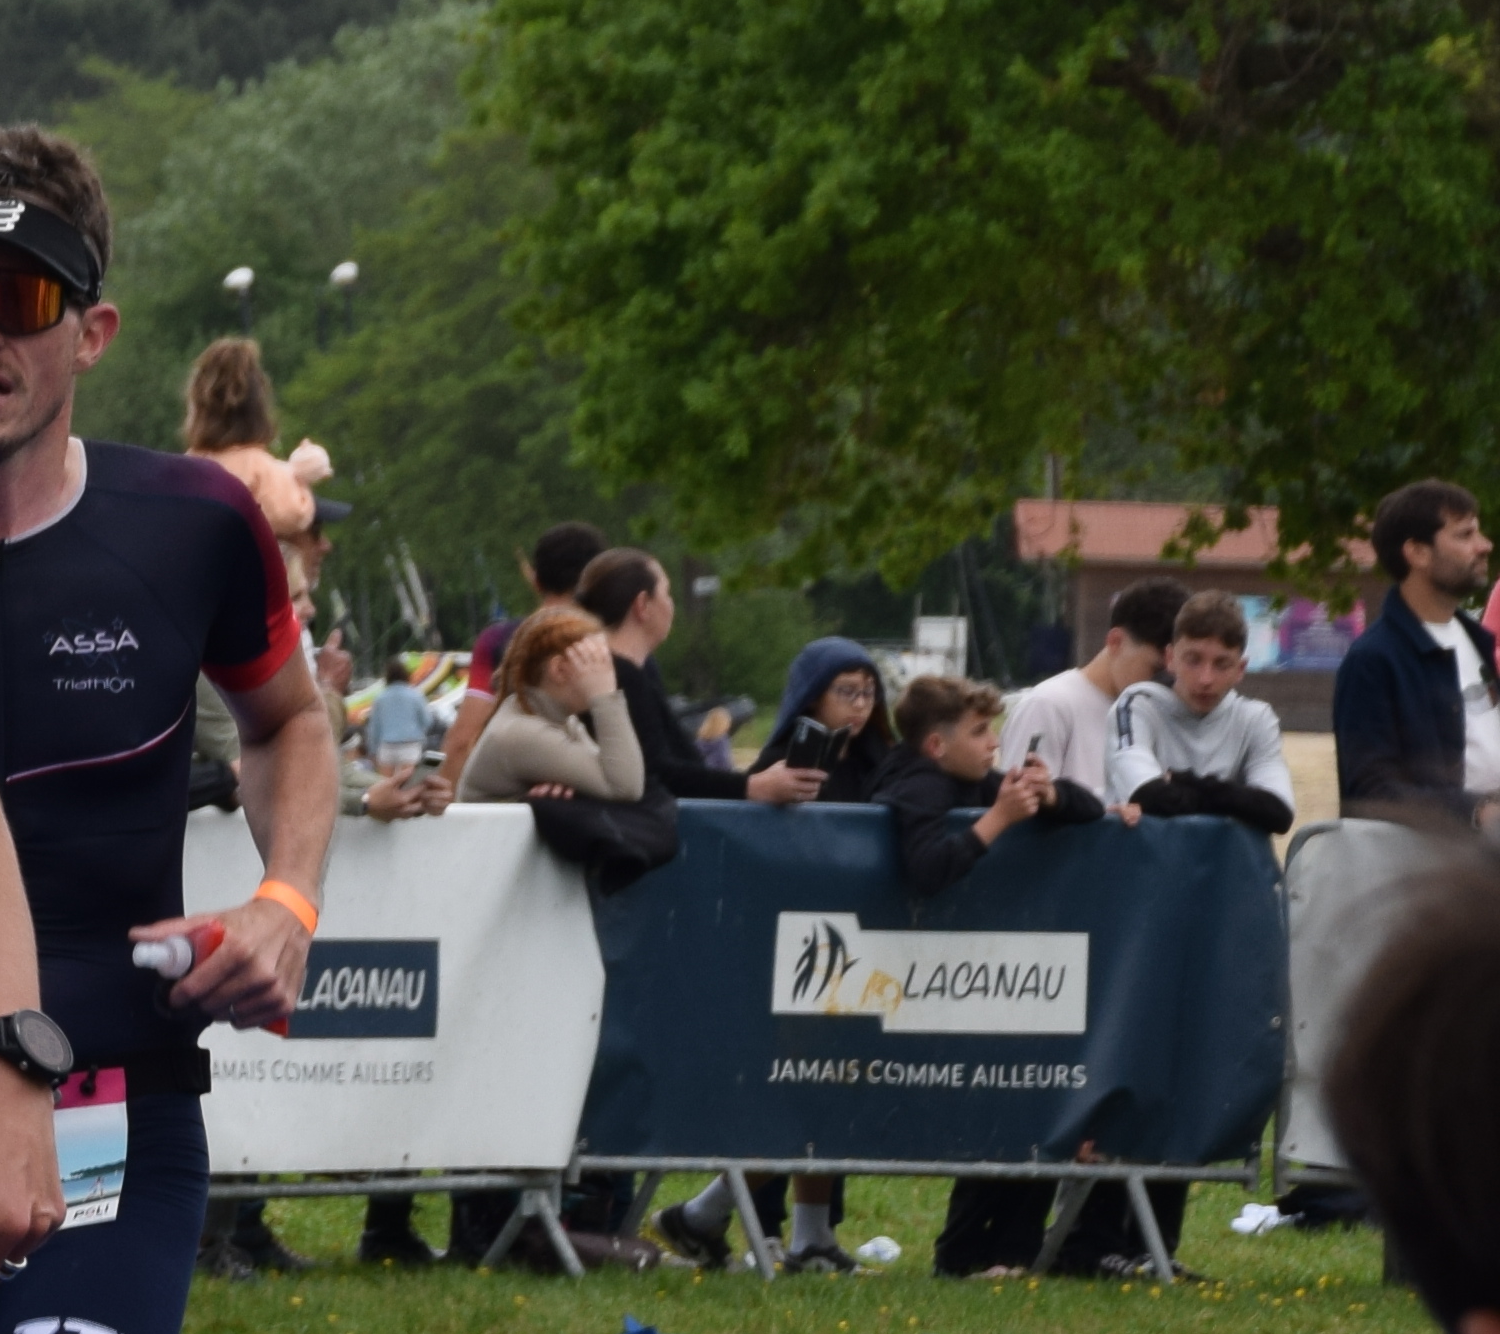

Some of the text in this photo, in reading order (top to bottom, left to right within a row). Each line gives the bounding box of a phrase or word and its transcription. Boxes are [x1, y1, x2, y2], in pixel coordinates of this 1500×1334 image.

[49, 629, 139, 656] ASSA
[295, 965, 426, 1011] LACANAU
[902, 960, 1067, 1004] LACANAU
[212, 1058, 435, 1085] AMAIS COMME AILLEURS
[767, 1057, 1088, 1089] JAMAIS COMME AILLEURS
